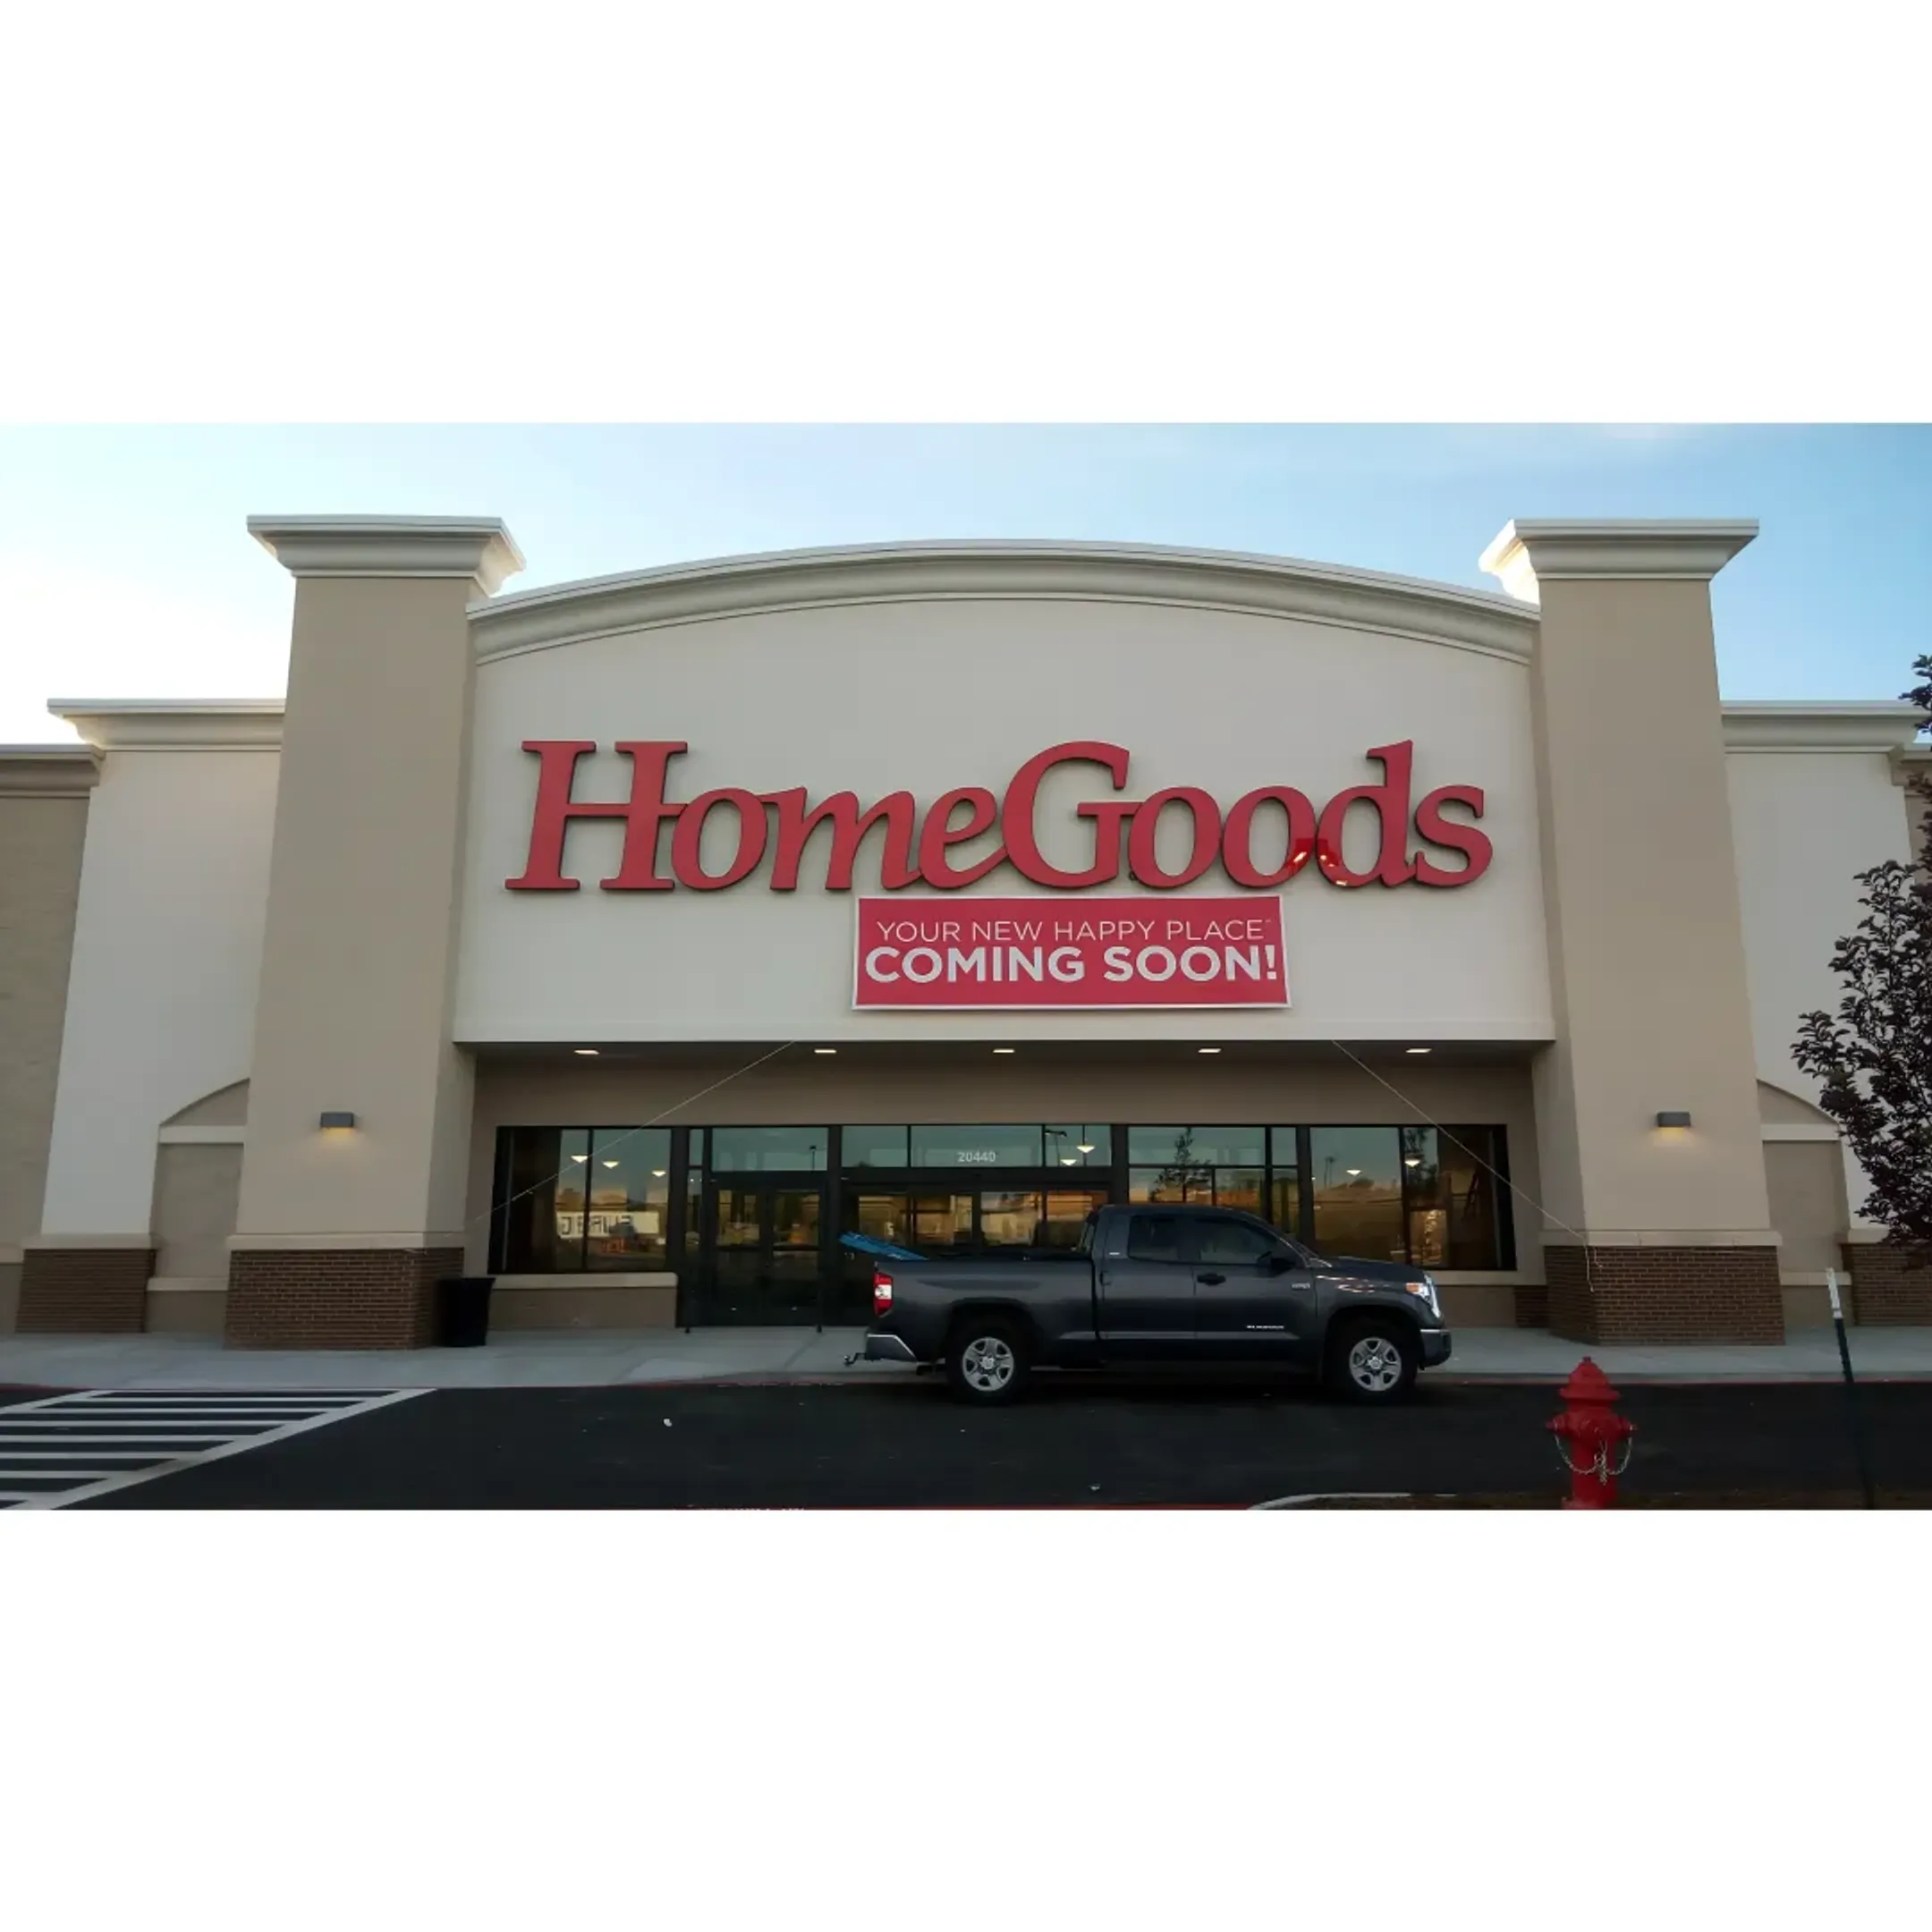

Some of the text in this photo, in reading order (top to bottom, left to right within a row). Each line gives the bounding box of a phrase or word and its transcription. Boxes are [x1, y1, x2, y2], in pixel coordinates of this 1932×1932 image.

[505, 740, 1493, 890] HomeGoods
[877, 919, 1264, 942] YOUR NEW HAPPY PLACE
[865, 945, 1277, 983] COMING SOON!
[957, 1151, 996, 1163] 20440
